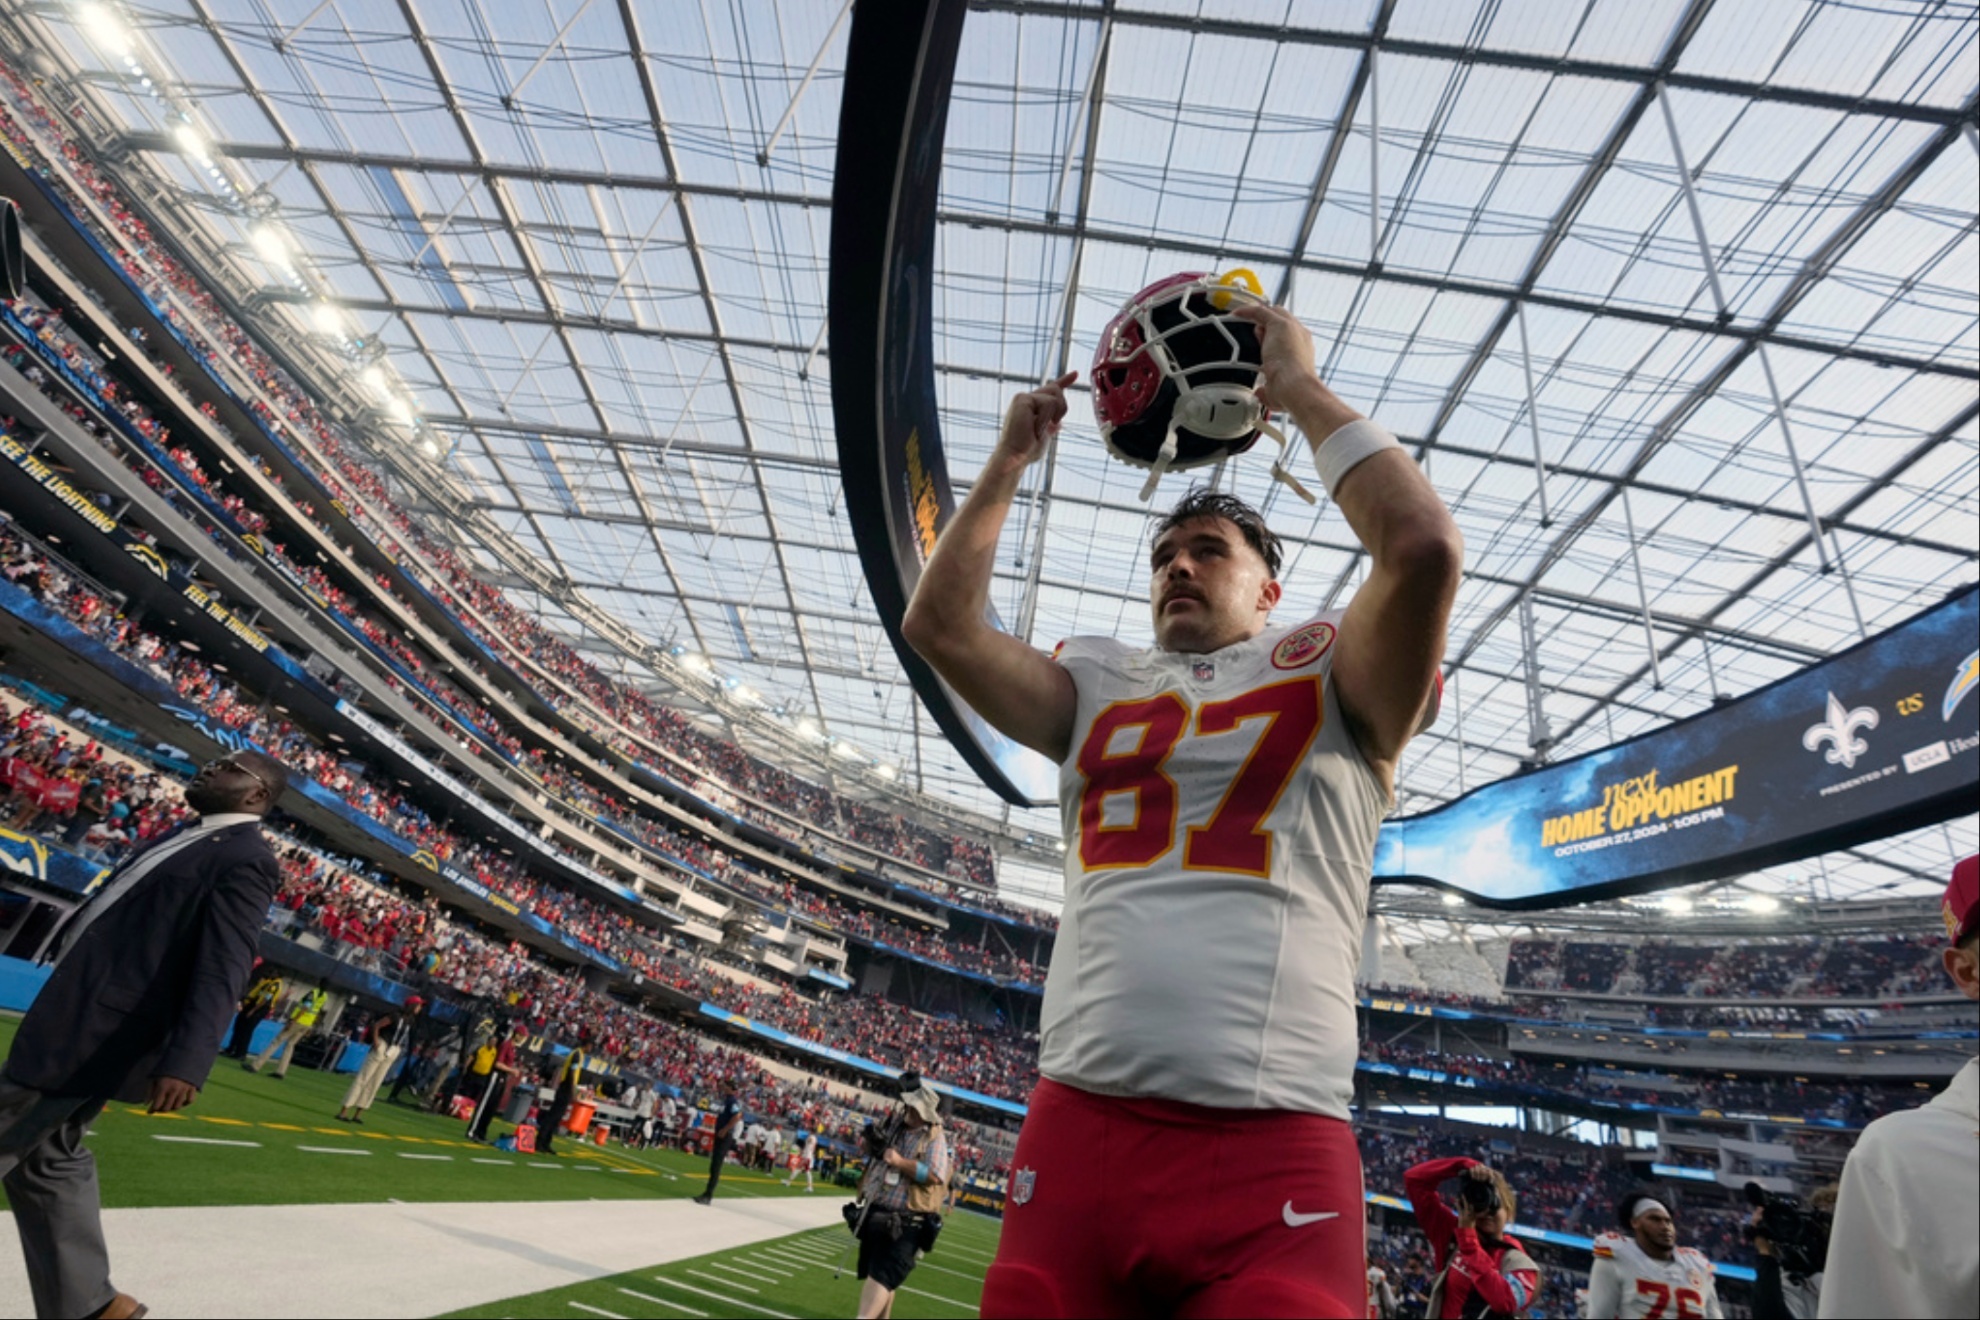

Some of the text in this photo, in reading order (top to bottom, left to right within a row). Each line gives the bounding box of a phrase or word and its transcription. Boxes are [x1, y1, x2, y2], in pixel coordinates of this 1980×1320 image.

[0, 435, 117, 533] SEE THE LIGHTNING
[183, 584, 269, 653] FEEL THE THUNDER
[1896, 692, 1924, 716] vs
[1076, 673, 1324, 879] 87
[1603, 767, 1660, 809] next
[1819, 770, 1882, 797] PRESENTED
[1881, 764, 1898, 776] BY
[1541, 764, 1739, 847] HOME OPPONENT
[1554, 806, 1725, 858] OCTOBER 27, 2024 1:05 PM
[1636, 1278, 1705, 1319] 76
